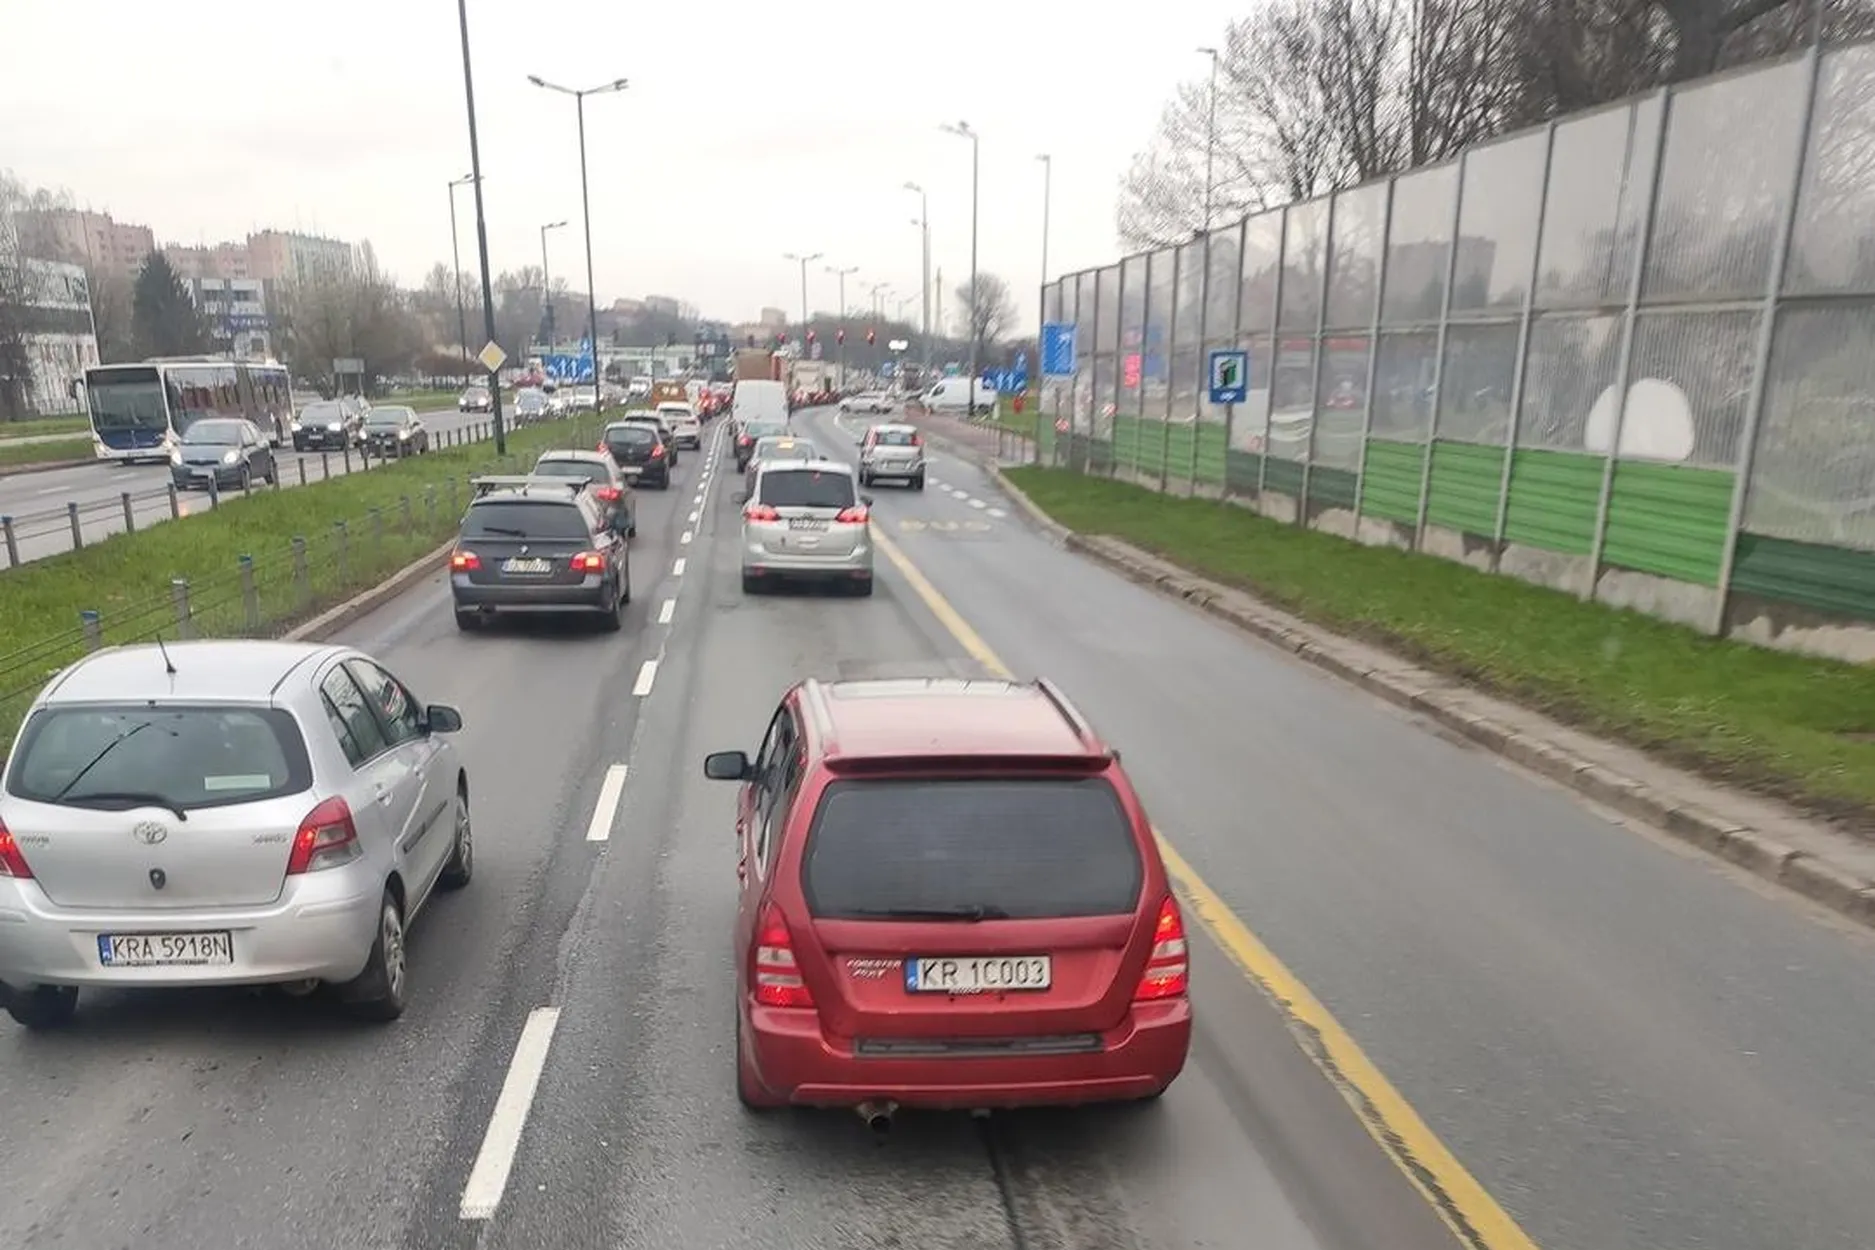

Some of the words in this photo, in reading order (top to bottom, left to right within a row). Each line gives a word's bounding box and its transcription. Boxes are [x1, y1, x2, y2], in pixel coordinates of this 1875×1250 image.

[113, 937, 154, 959] KRA
[161, 936, 227, 958] 5918N
[922, 960, 958, 985] KR
[971, 960, 1044, 984] 1C003
